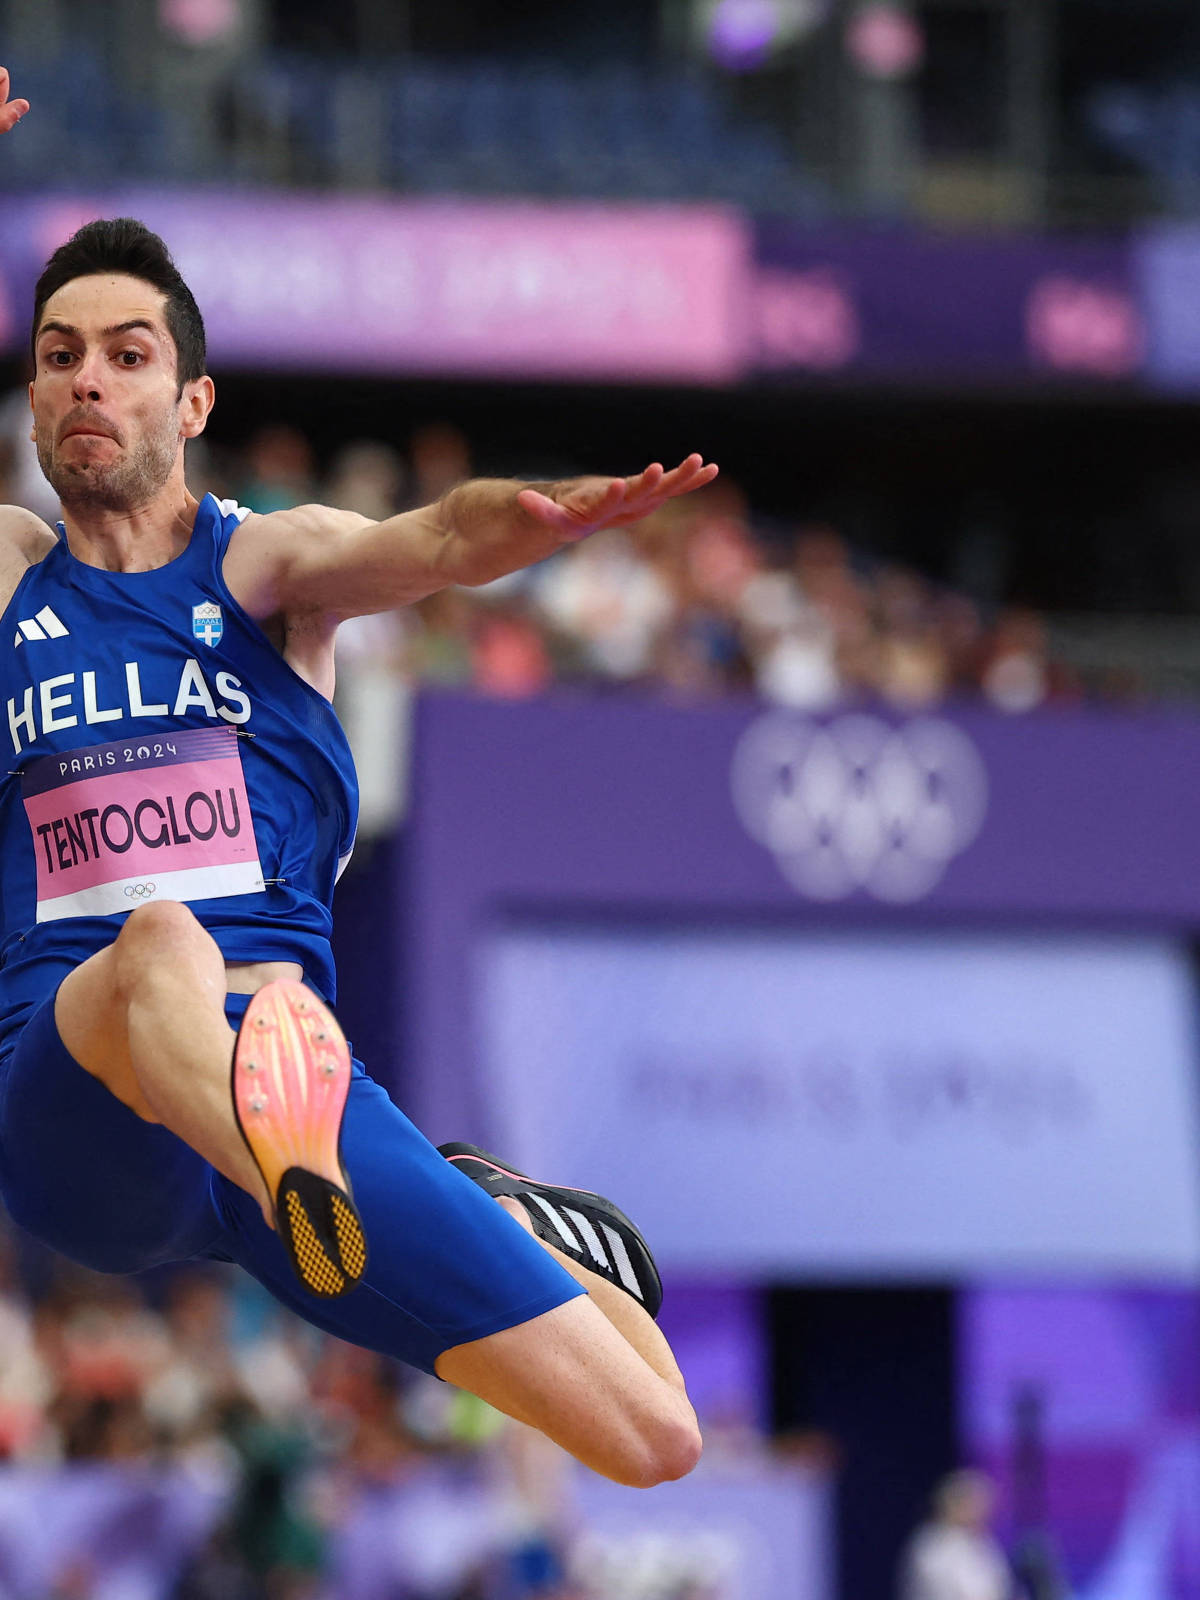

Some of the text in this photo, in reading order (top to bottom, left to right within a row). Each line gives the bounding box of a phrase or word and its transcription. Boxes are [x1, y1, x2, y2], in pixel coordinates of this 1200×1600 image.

[7, 658, 252, 755] HELLAS
[123, 742, 177, 763] 2024
[36, 787, 242, 874] TENTOGLOU
